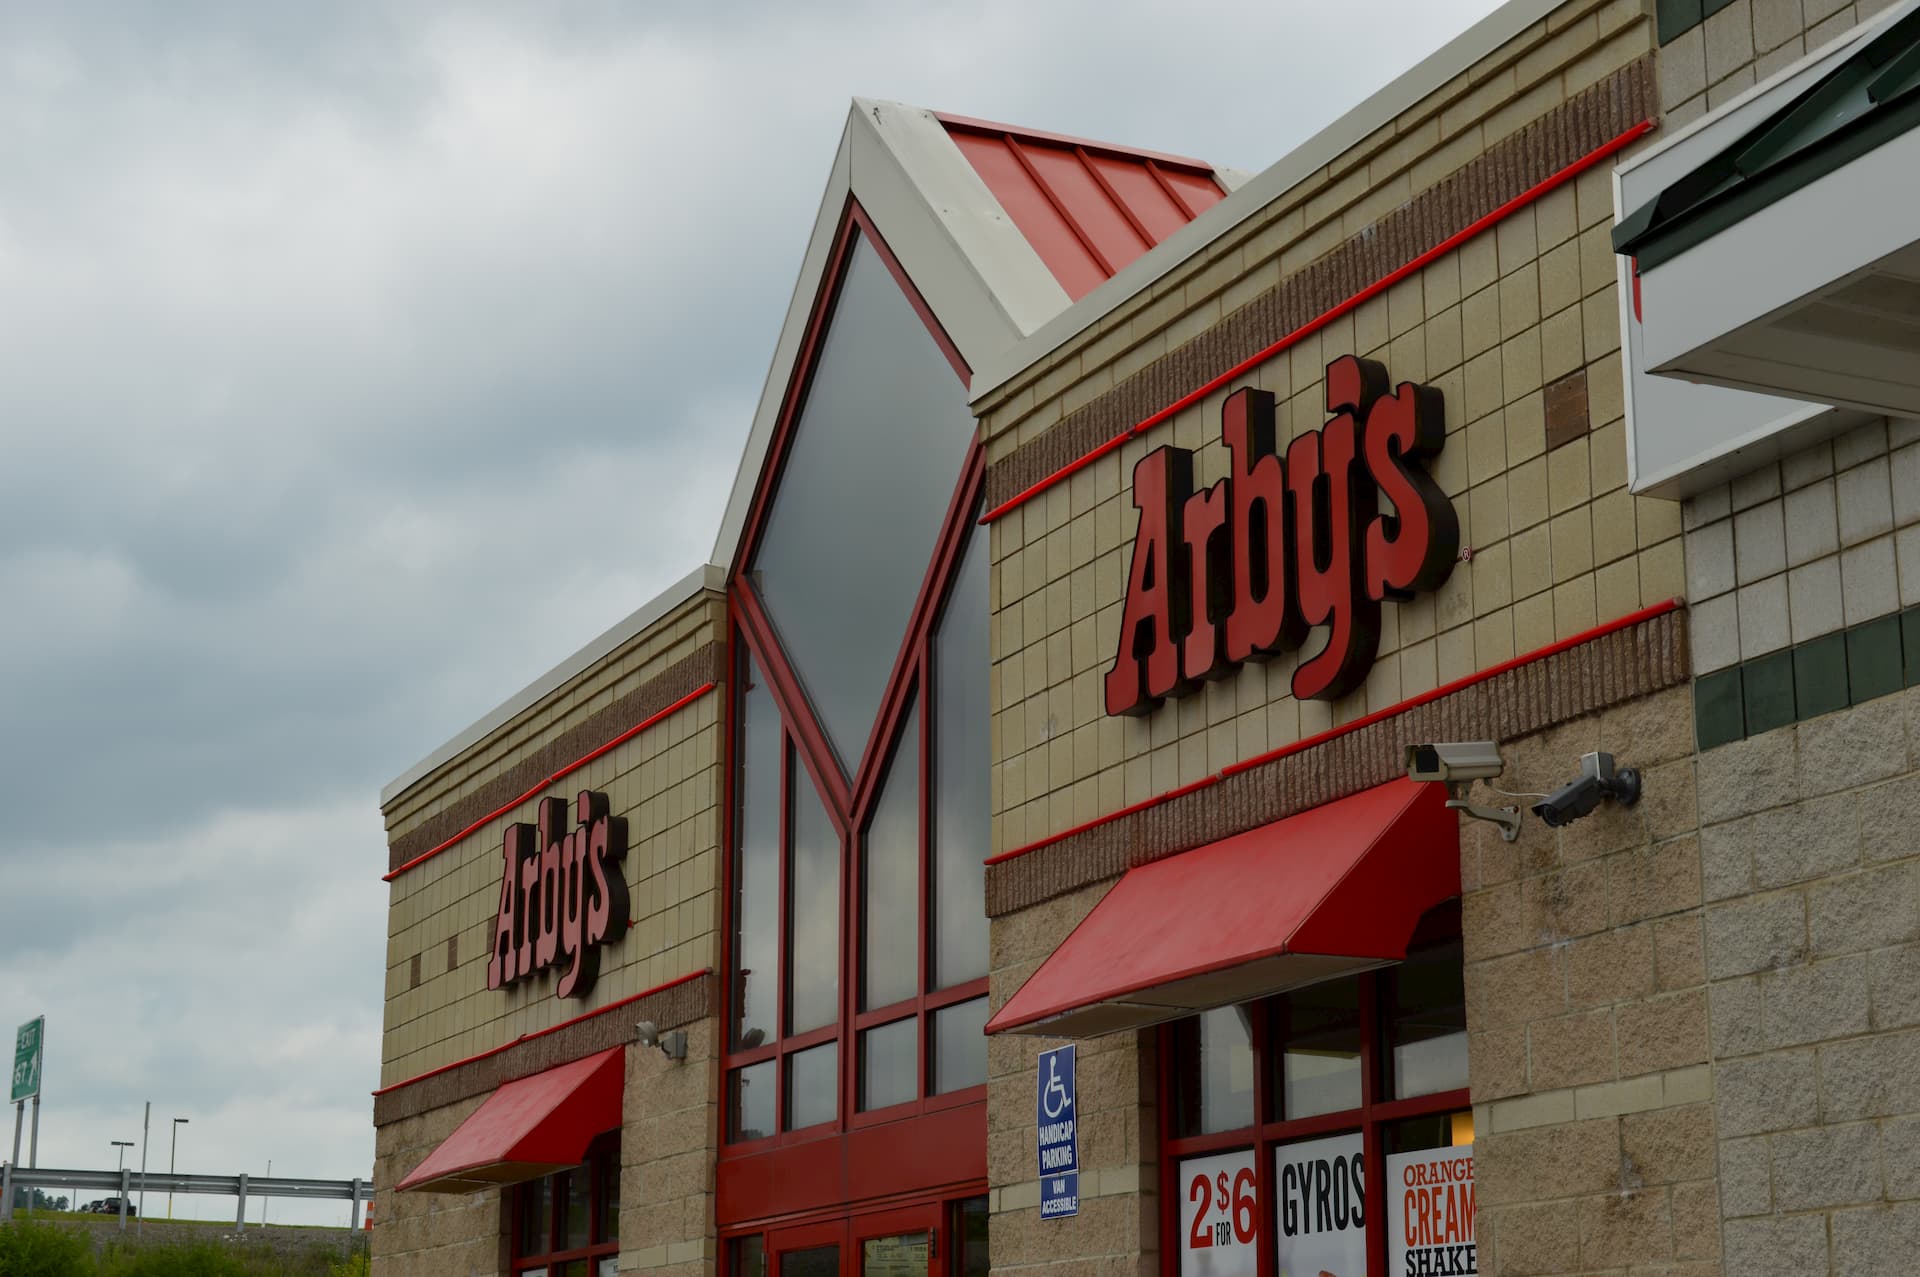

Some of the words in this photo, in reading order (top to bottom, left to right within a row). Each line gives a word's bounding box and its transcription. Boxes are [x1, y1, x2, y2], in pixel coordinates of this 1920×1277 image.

[1104, 354, 1456, 718] Arby's
[487, 789, 628, 1000] Arby's
[1039, 1120, 1074, 1147] HANDICAP
[1041, 1144, 1073, 1170] PARKING
[1041, 1196, 1077, 1215] ACCESSIBLE
[1052, 1178, 1066, 1195] VAN
[1189, 1173, 1214, 1249] 2
[1215, 1221, 1232, 1247] FOR
[1281, 1152, 1367, 1237] GYROS
